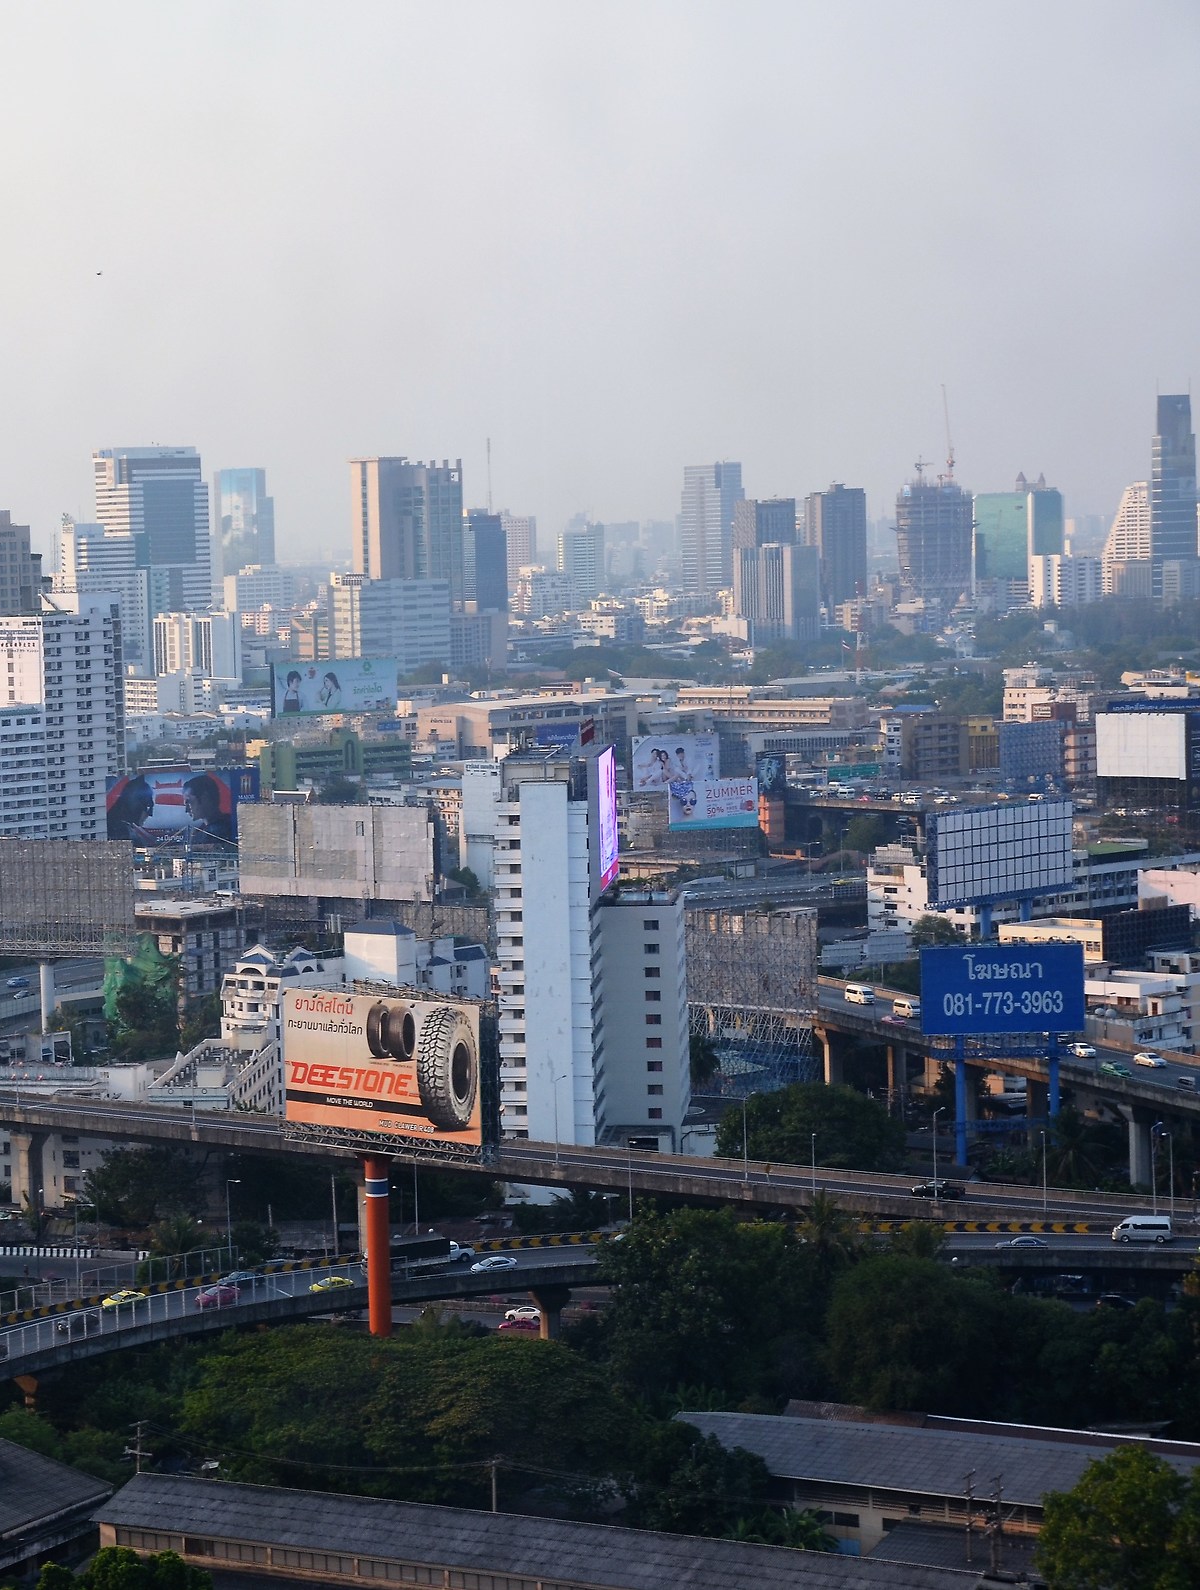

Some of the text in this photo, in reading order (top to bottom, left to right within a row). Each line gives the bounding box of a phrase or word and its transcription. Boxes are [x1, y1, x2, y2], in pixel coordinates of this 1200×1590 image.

[706, 785, 753, 799] ZUMMER
[707, 806, 724, 815] 50%
[962, 954, 1043, 980] โฆษณา
[295, 995, 354, 1016] ยางดีสโตน
[943, 990, 1064, 1016] 081-773-3963
[290, 1061, 413, 1097] DEESTONE
[353, 1099, 373, 1108] WORLD
[379, 1119, 392, 1128] MUD
